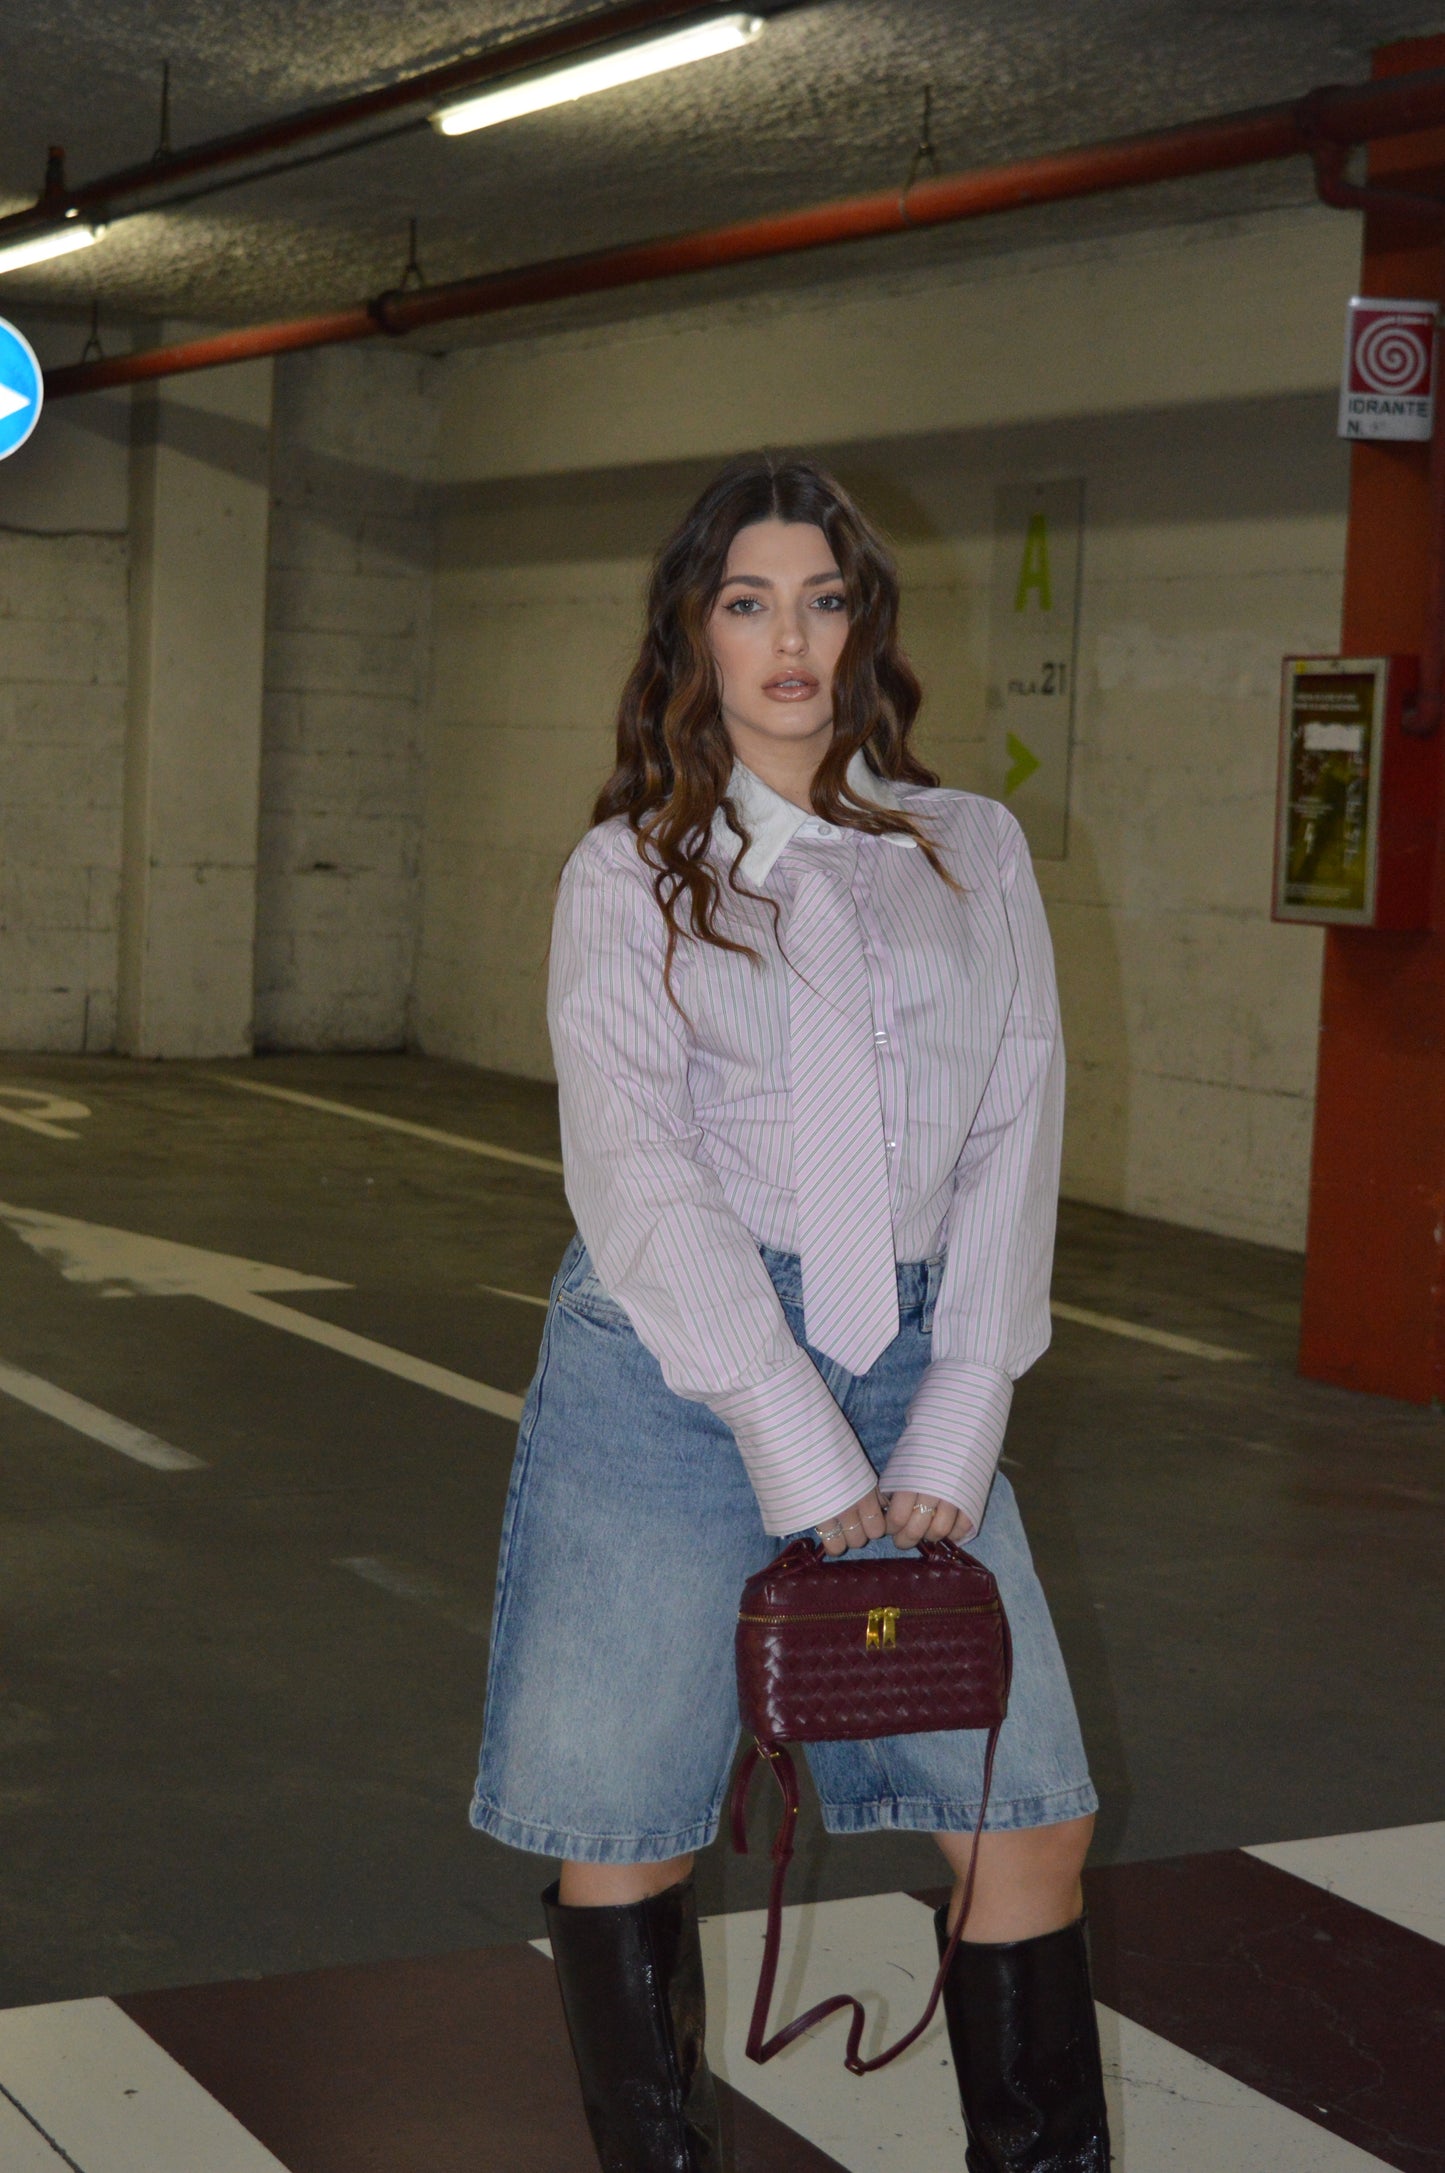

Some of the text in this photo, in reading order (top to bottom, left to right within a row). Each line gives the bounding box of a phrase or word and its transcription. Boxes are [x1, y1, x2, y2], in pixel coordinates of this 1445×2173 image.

[1348, 399, 1428, 418] IDRANTE
[1015, 511, 1052, 612] A
[1041, 661, 1066, 696] 21
